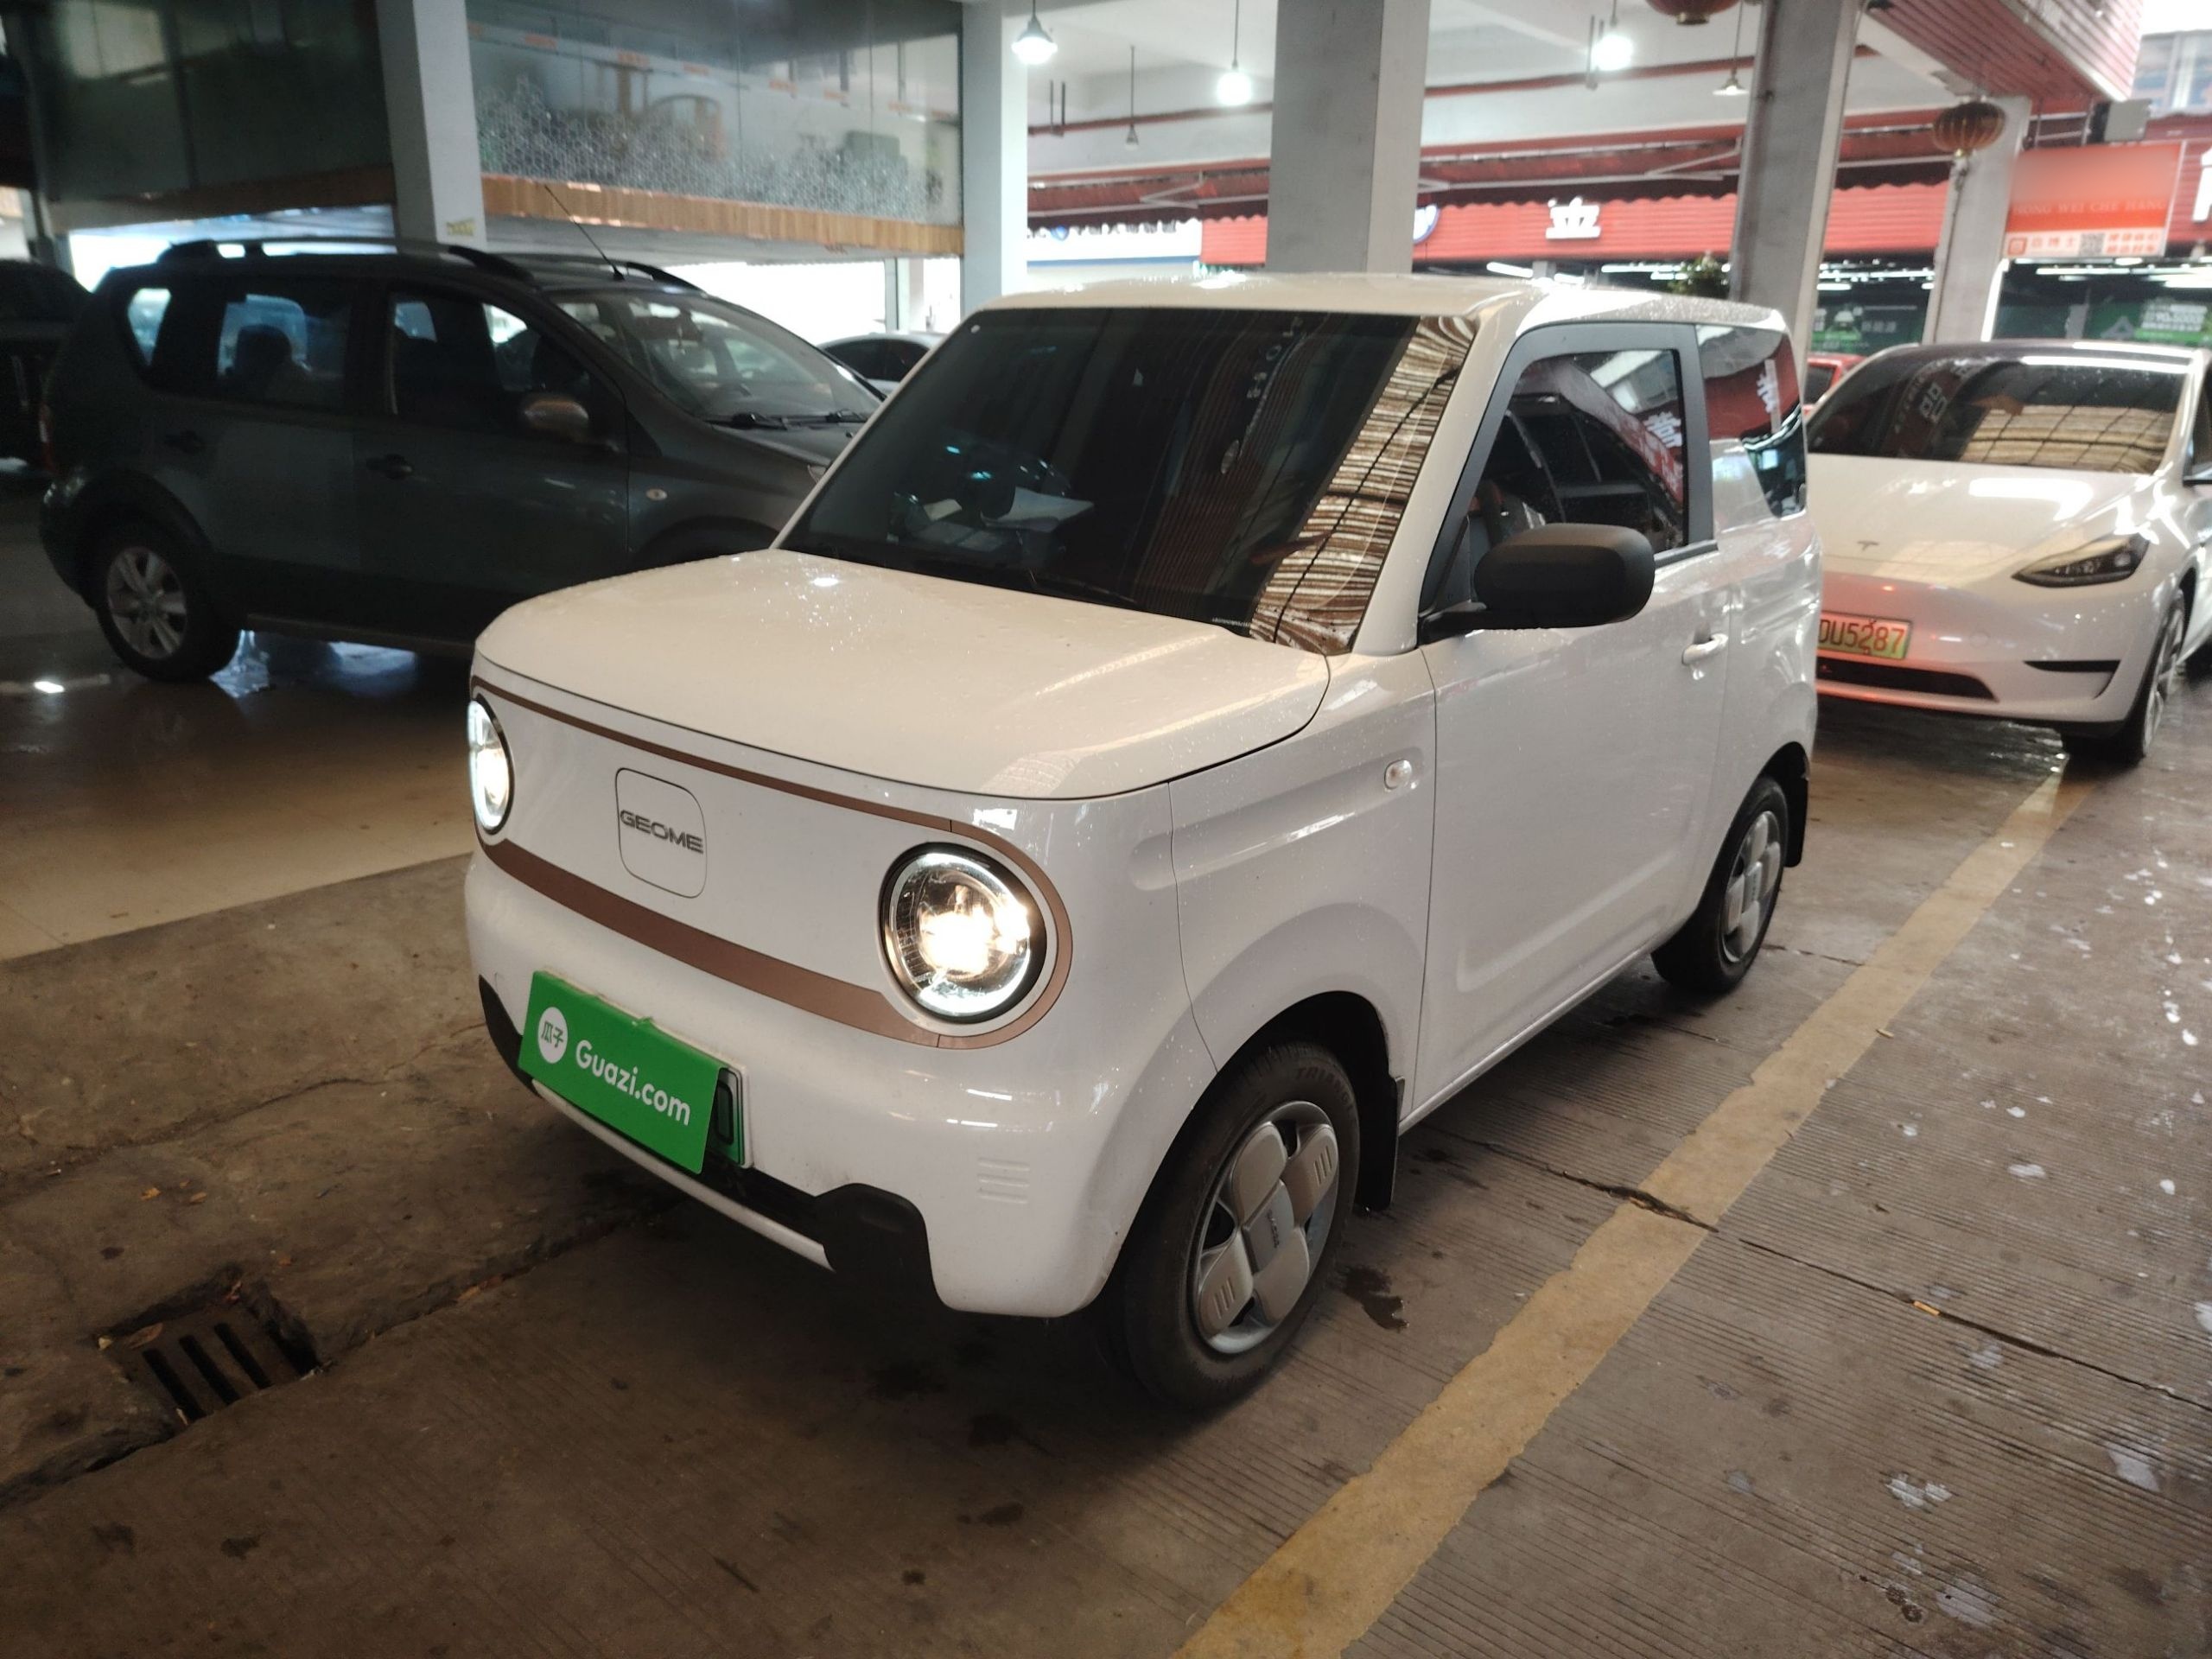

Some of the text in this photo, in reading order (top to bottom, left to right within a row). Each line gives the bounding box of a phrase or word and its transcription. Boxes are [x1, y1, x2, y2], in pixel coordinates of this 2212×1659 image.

[1818, 619, 1905, 654] DU5287
[620, 809, 704, 855] GEOME
[541, 1020, 564, 1048] 瓜子
[575, 1039, 691, 1126] Guazi.com
